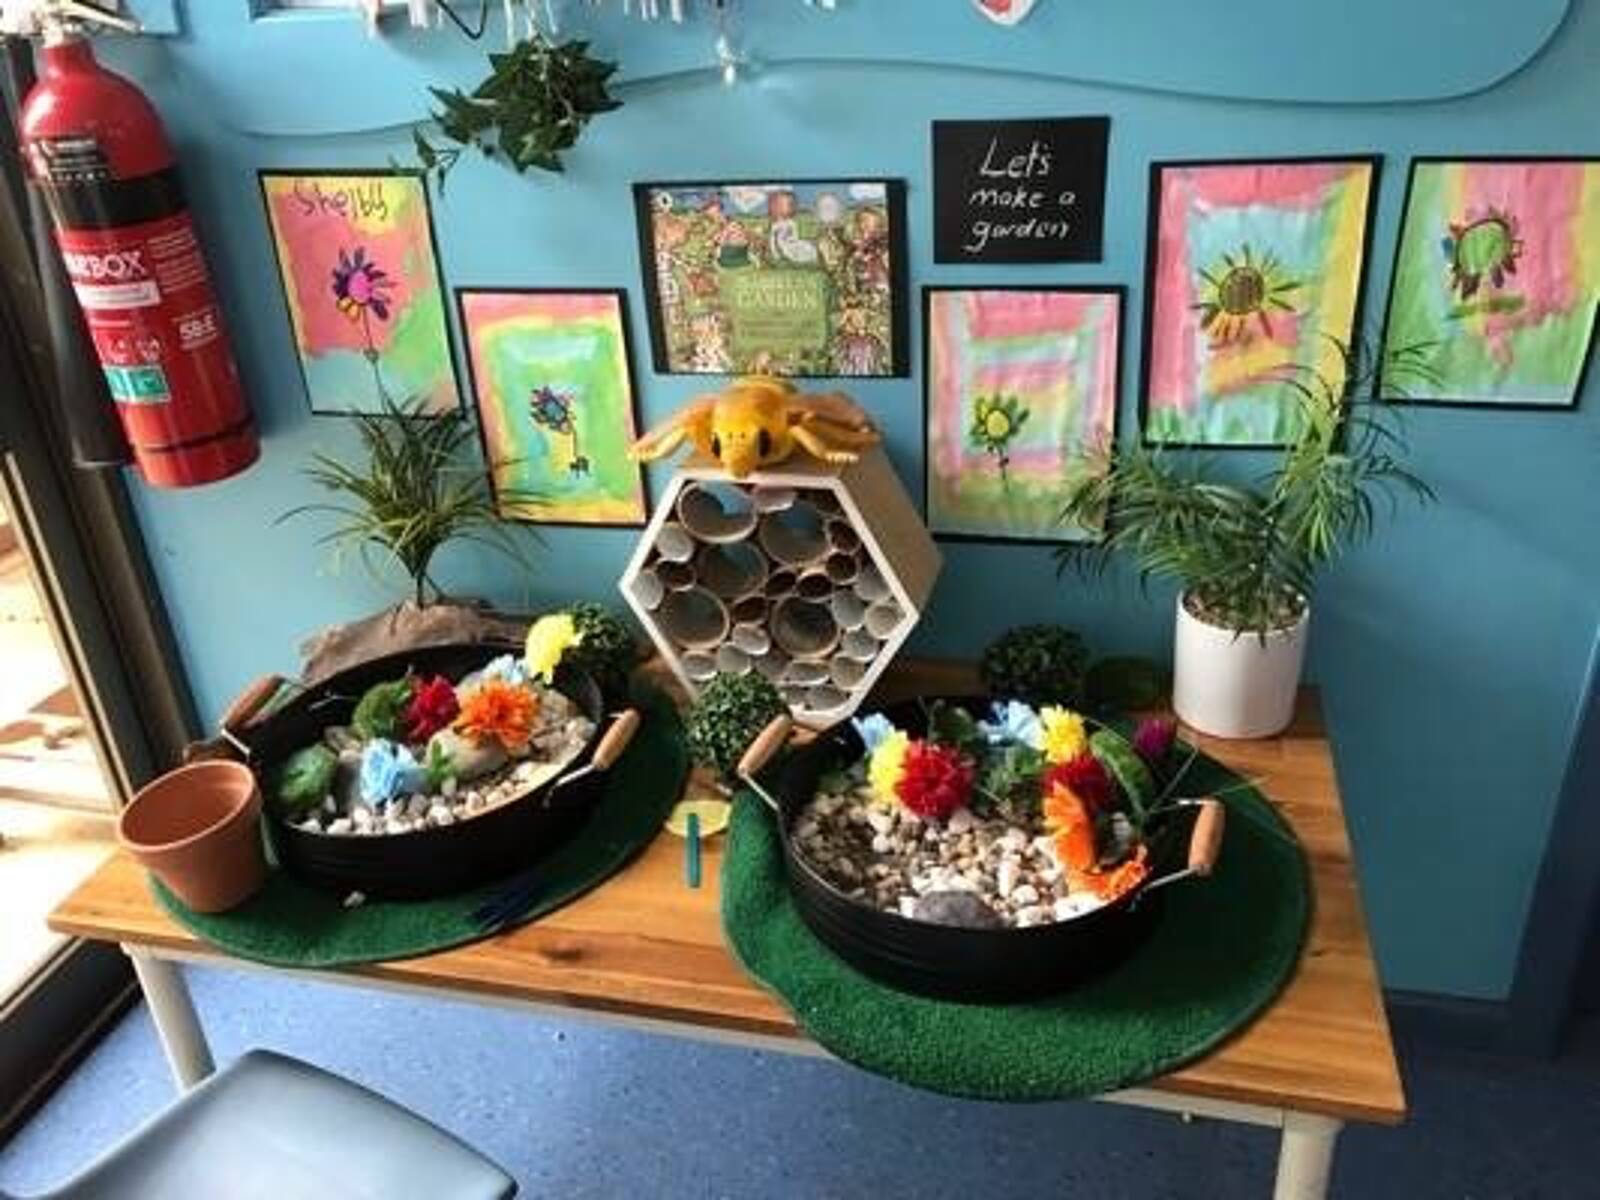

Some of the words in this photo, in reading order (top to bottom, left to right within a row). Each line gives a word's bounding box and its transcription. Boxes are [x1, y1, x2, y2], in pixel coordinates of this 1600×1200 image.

[979, 136, 1052, 178] Let's
[291, 179, 388, 221] Shelby
[969, 185, 1046, 209] make
[1058, 190, 1076, 206] a
[962, 217, 1070, 253] garden
